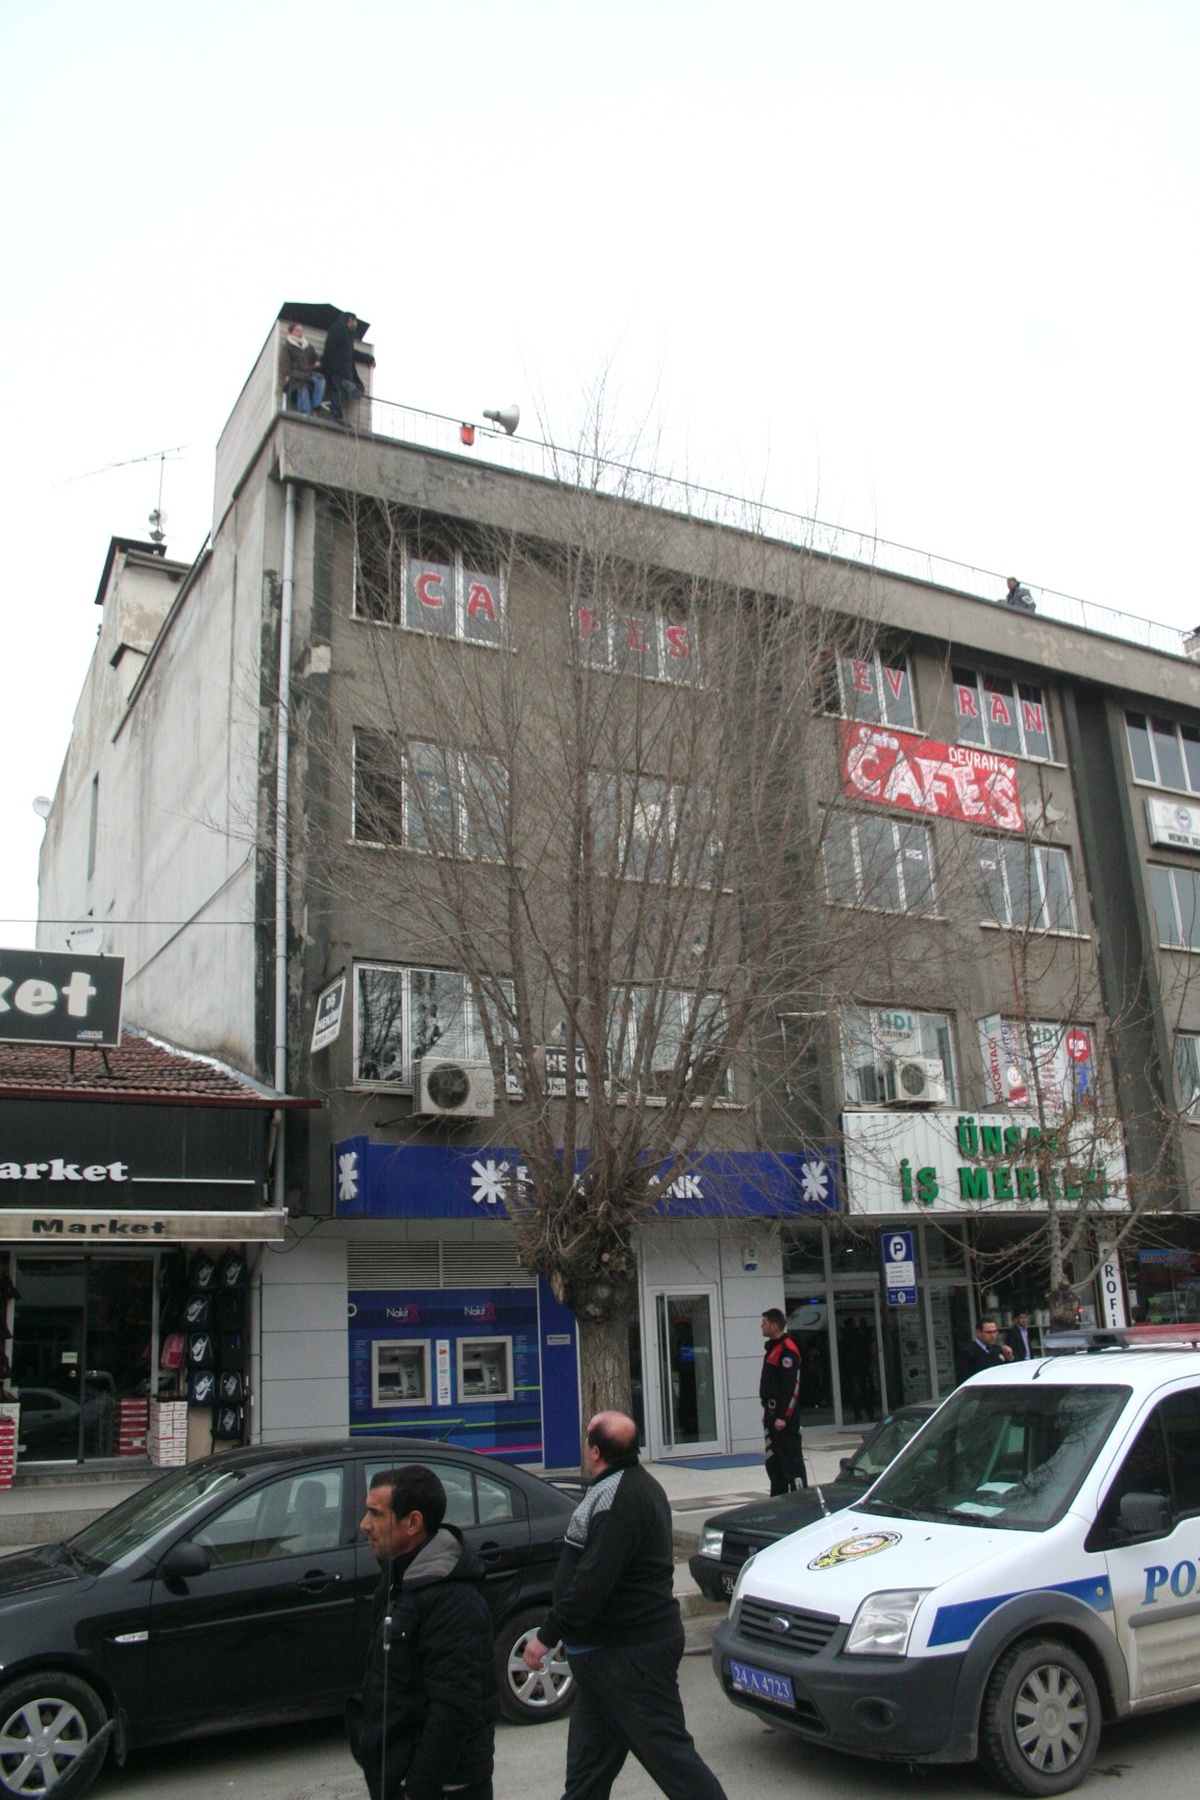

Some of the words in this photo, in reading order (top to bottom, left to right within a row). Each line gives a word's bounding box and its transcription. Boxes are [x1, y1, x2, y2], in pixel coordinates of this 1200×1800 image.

[878, 1012, 914, 1031] HDI
[900, 1158, 939, 1204] İŞ
[31, 1219, 166, 1235] Market
[893, 1242, 904, 1255] P
[1141, 1556, 1200, 1606] PO
[734, 1666, 748, 1685] 24
[751, 1672, 760, 1689] A
[761, 1675, 790, 1699] 4723
